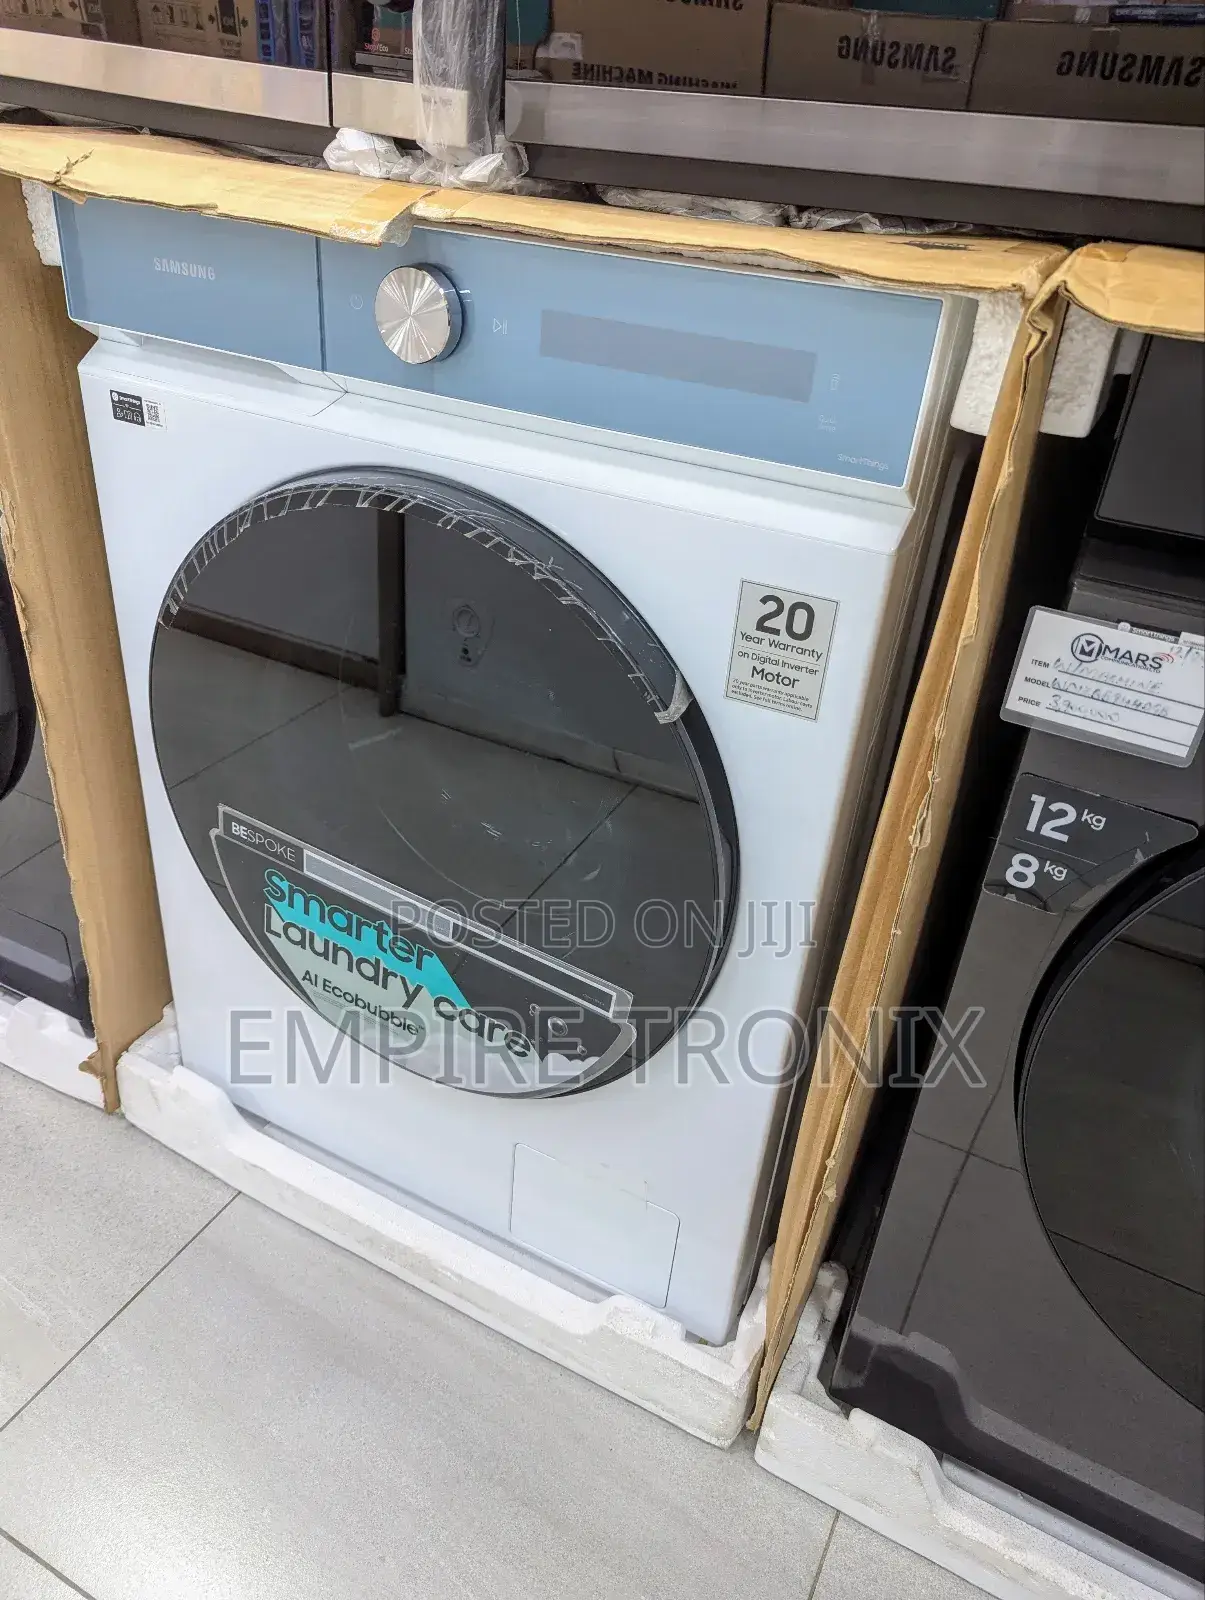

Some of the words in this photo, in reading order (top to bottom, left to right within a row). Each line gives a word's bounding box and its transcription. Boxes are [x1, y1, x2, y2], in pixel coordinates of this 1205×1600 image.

[153, 256, 216, 281] SAMSUNG
[755, 594, 815, 641] 20
[740, 631, 765, 646] Year
[768, 638, 823, 661] Warranty
[1102, 643, 1163, 671] MARS
[737, 650, 750, 659] on
[751, 652, 780, 668] Digital
[781, 660, 820, 676] Inverter
[751, 665, 800, 688] Motor
[1031, 658, 1050, 669] ITEM
[1024, 676, 1051, 689] MODEL
[1018, 696, 1041, 708] PRICE
[1026, 793, 1077, 843] 12
[1081, 809, 1107, 831] kg
[231, 821, 296, 863] BESPOKE
[1005, 853, 1039, 889] 8
[1043, 861, 1068, 881] kg
[263, 868, 435, 972] Smarter
[264, 903, 424, 1011] Laundry
[433, 995, 531, 1058] care
[301, 969, 318, 988] AI
